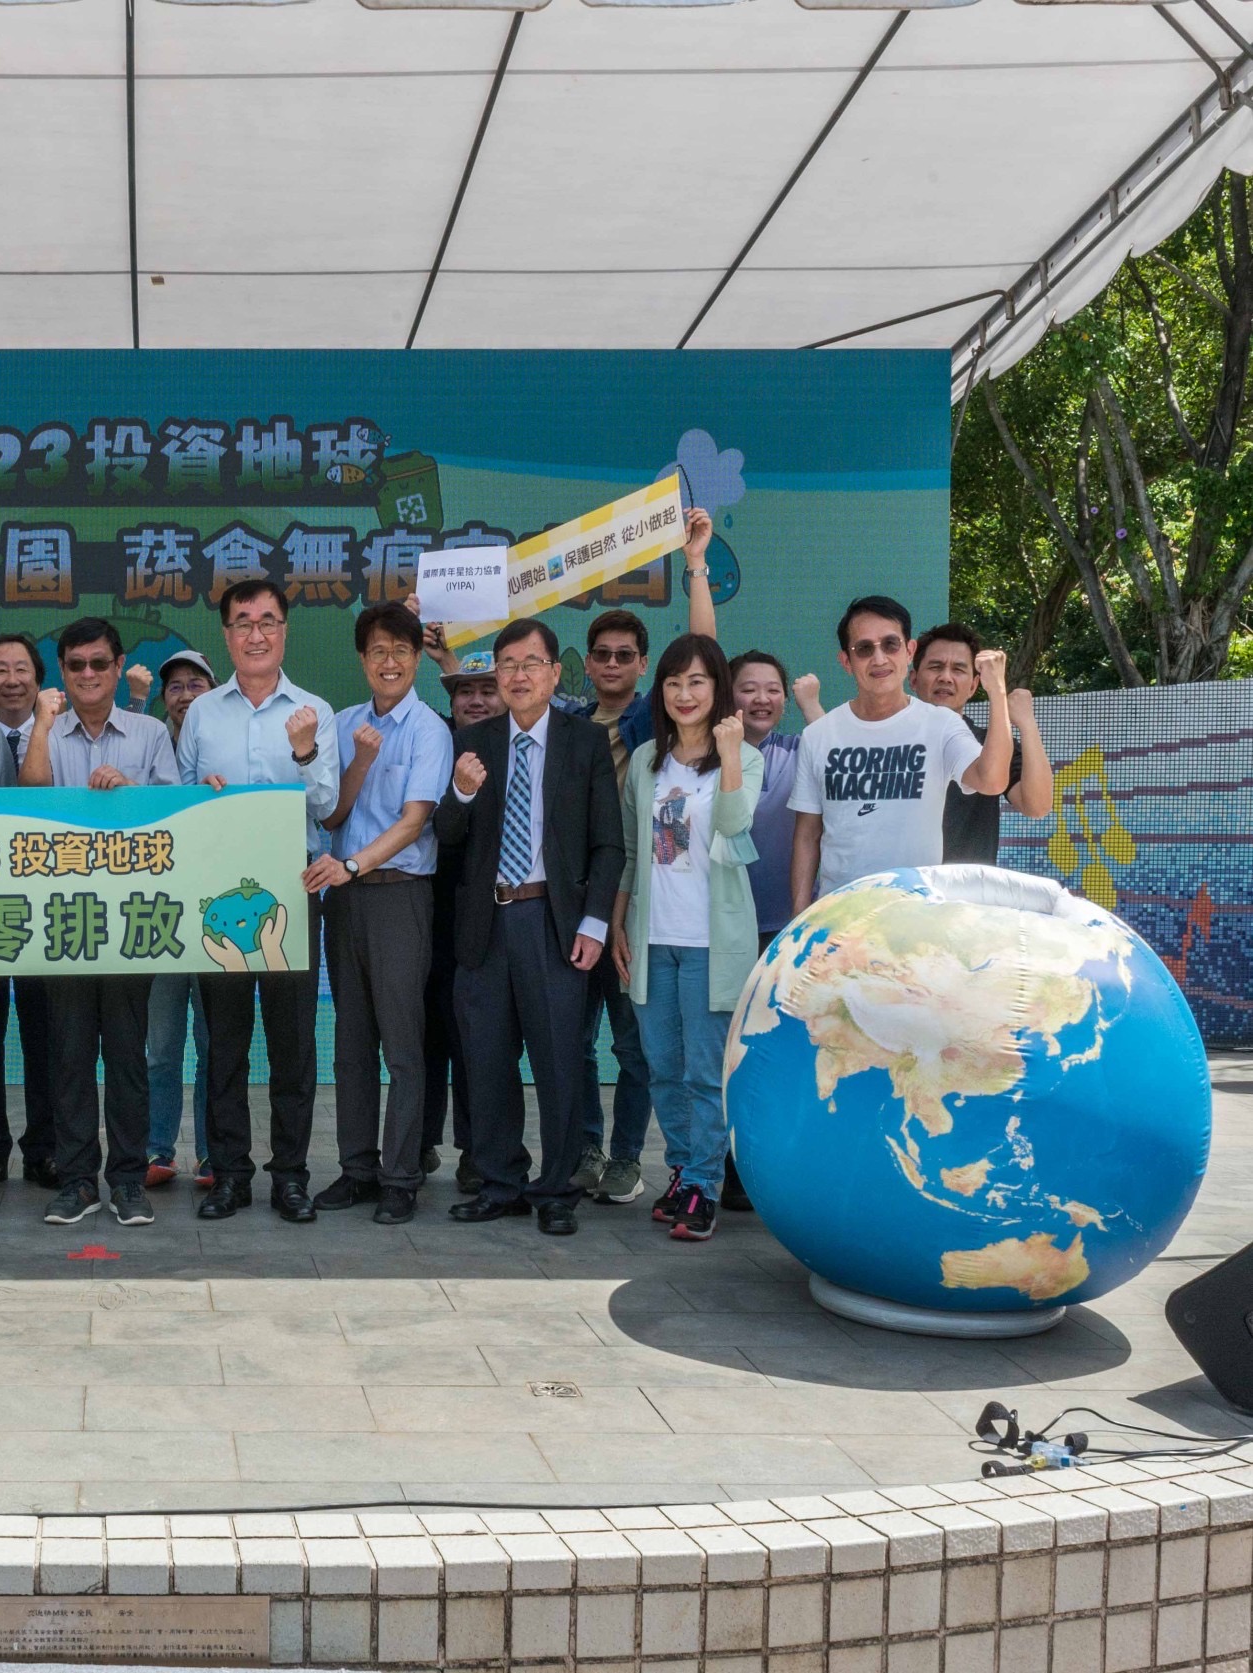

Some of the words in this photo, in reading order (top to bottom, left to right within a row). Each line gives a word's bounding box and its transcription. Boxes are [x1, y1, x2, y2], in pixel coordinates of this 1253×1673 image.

[507, 565, 547, 598] 心開始
[564, 532, 617, 571] 保護自然
[621, 505, 677, 546] 從小做起
[446, 581, 475, 592] (IYIPA)
[825, 744, 927, 774] SCORING
[825, 772, 926, 801] MACHINE
[862, 803, 876, 811] NIKE
[9, 831, 175, 876] 投資地球
